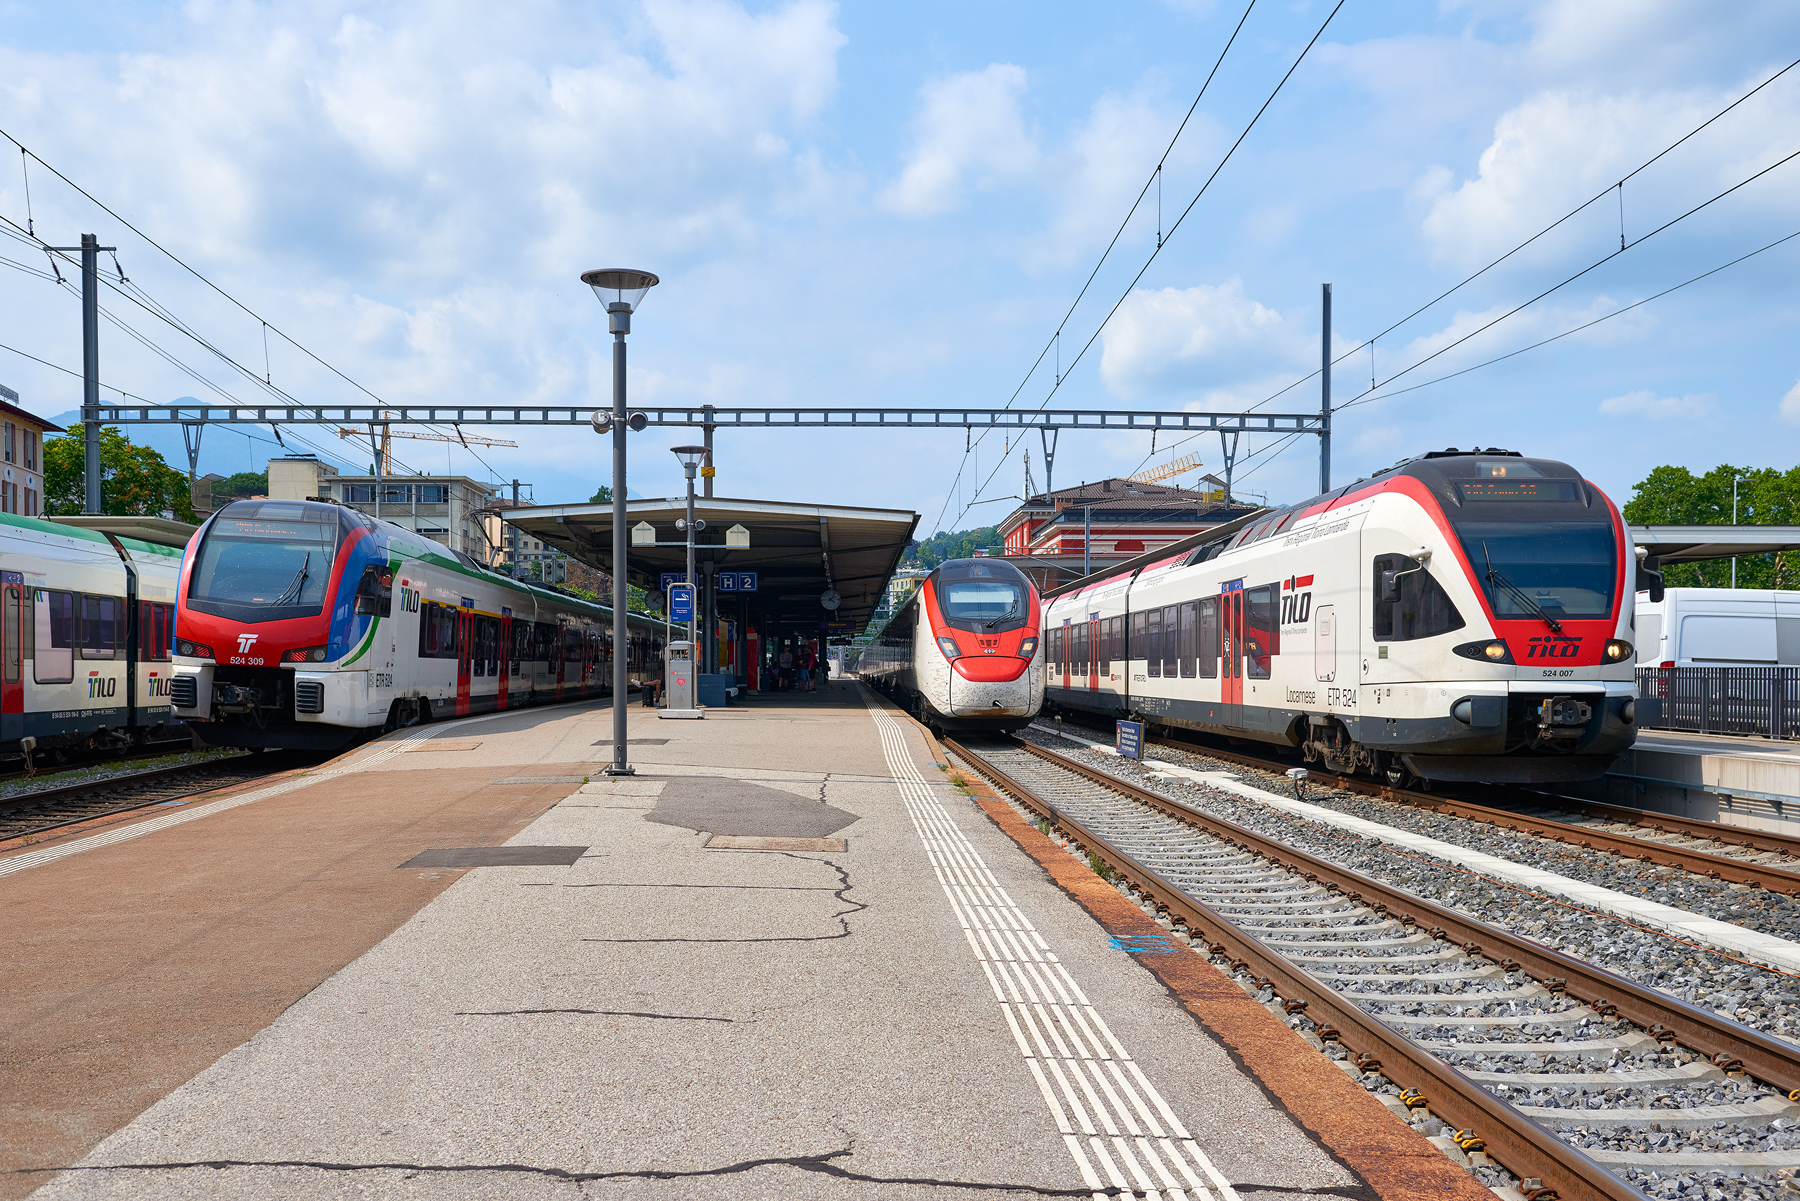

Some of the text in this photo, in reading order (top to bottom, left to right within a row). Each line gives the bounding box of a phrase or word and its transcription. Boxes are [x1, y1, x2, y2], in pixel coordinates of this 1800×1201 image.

[724, 578, 733, 588] H
[744, 578, 752, 588] 2
[401, 580, 420, 613] TILO
[1281, 575, 1312, 625] TILO
[1527, 636, 1582, 657] TILO
[230, 656, 264, 666] 524 309
[88, 671, 116, 699] TILO
[1328, 687, 1357, 707] ETR 524
